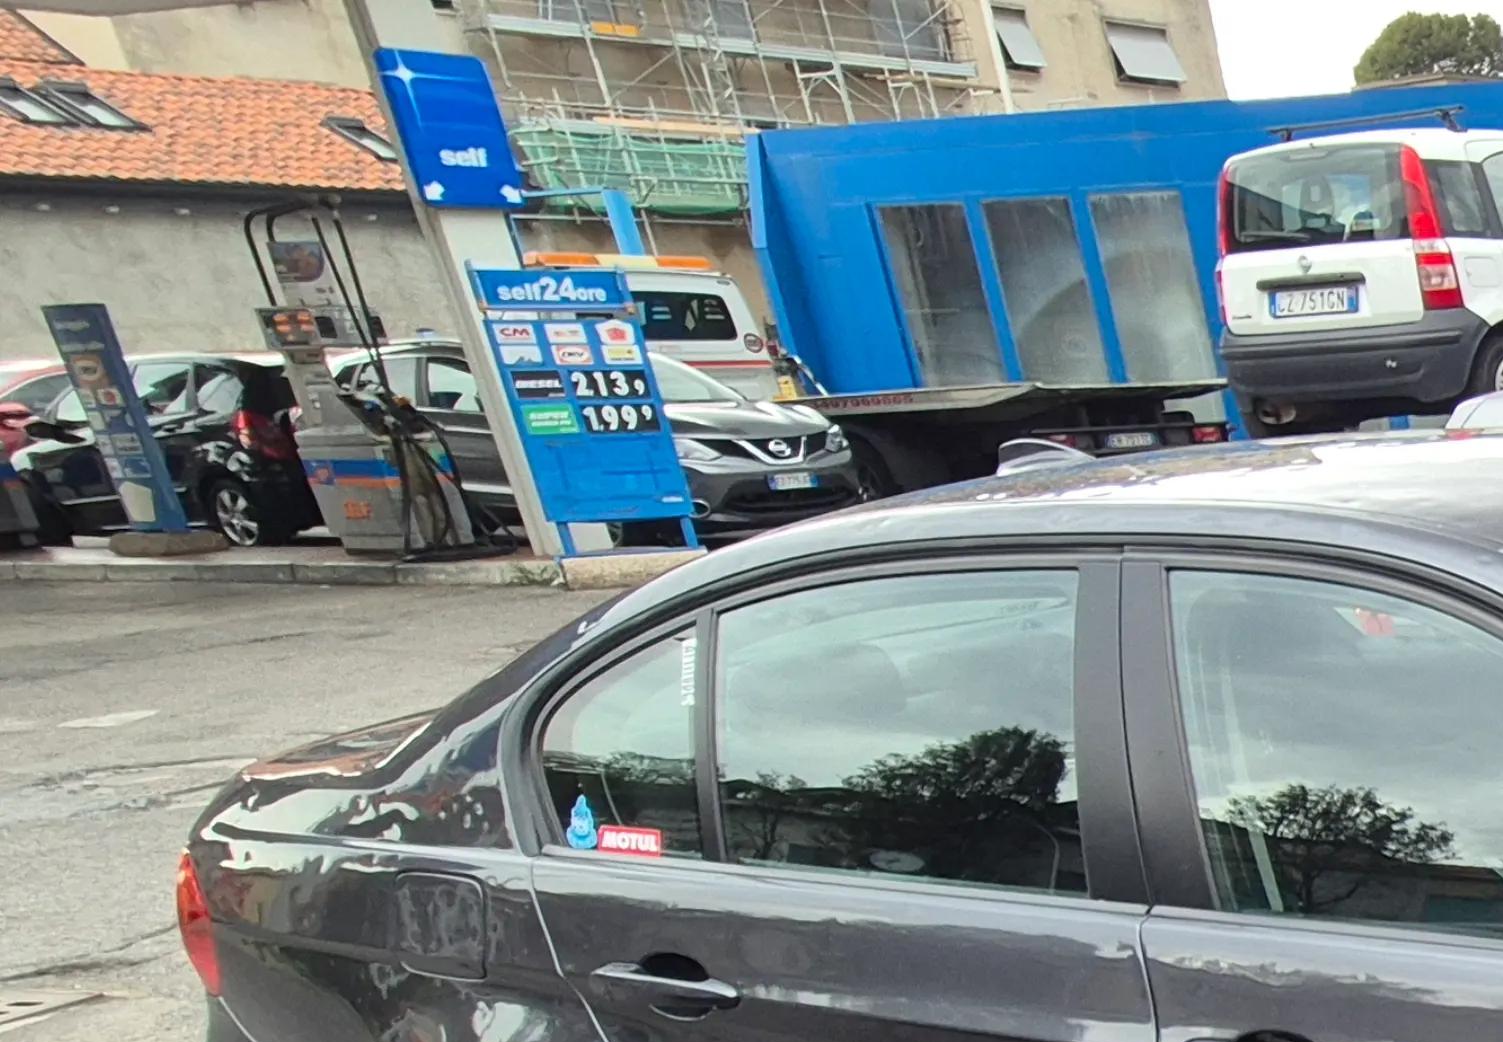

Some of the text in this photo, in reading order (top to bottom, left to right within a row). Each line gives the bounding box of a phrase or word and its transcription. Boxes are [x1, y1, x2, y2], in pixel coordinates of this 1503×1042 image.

[439, 147, 488, 168] self
[496, 276, 607, 302] self24ore
[499, 327, 530, 338] CM
[602, 831, 658, 852] MOTUL
